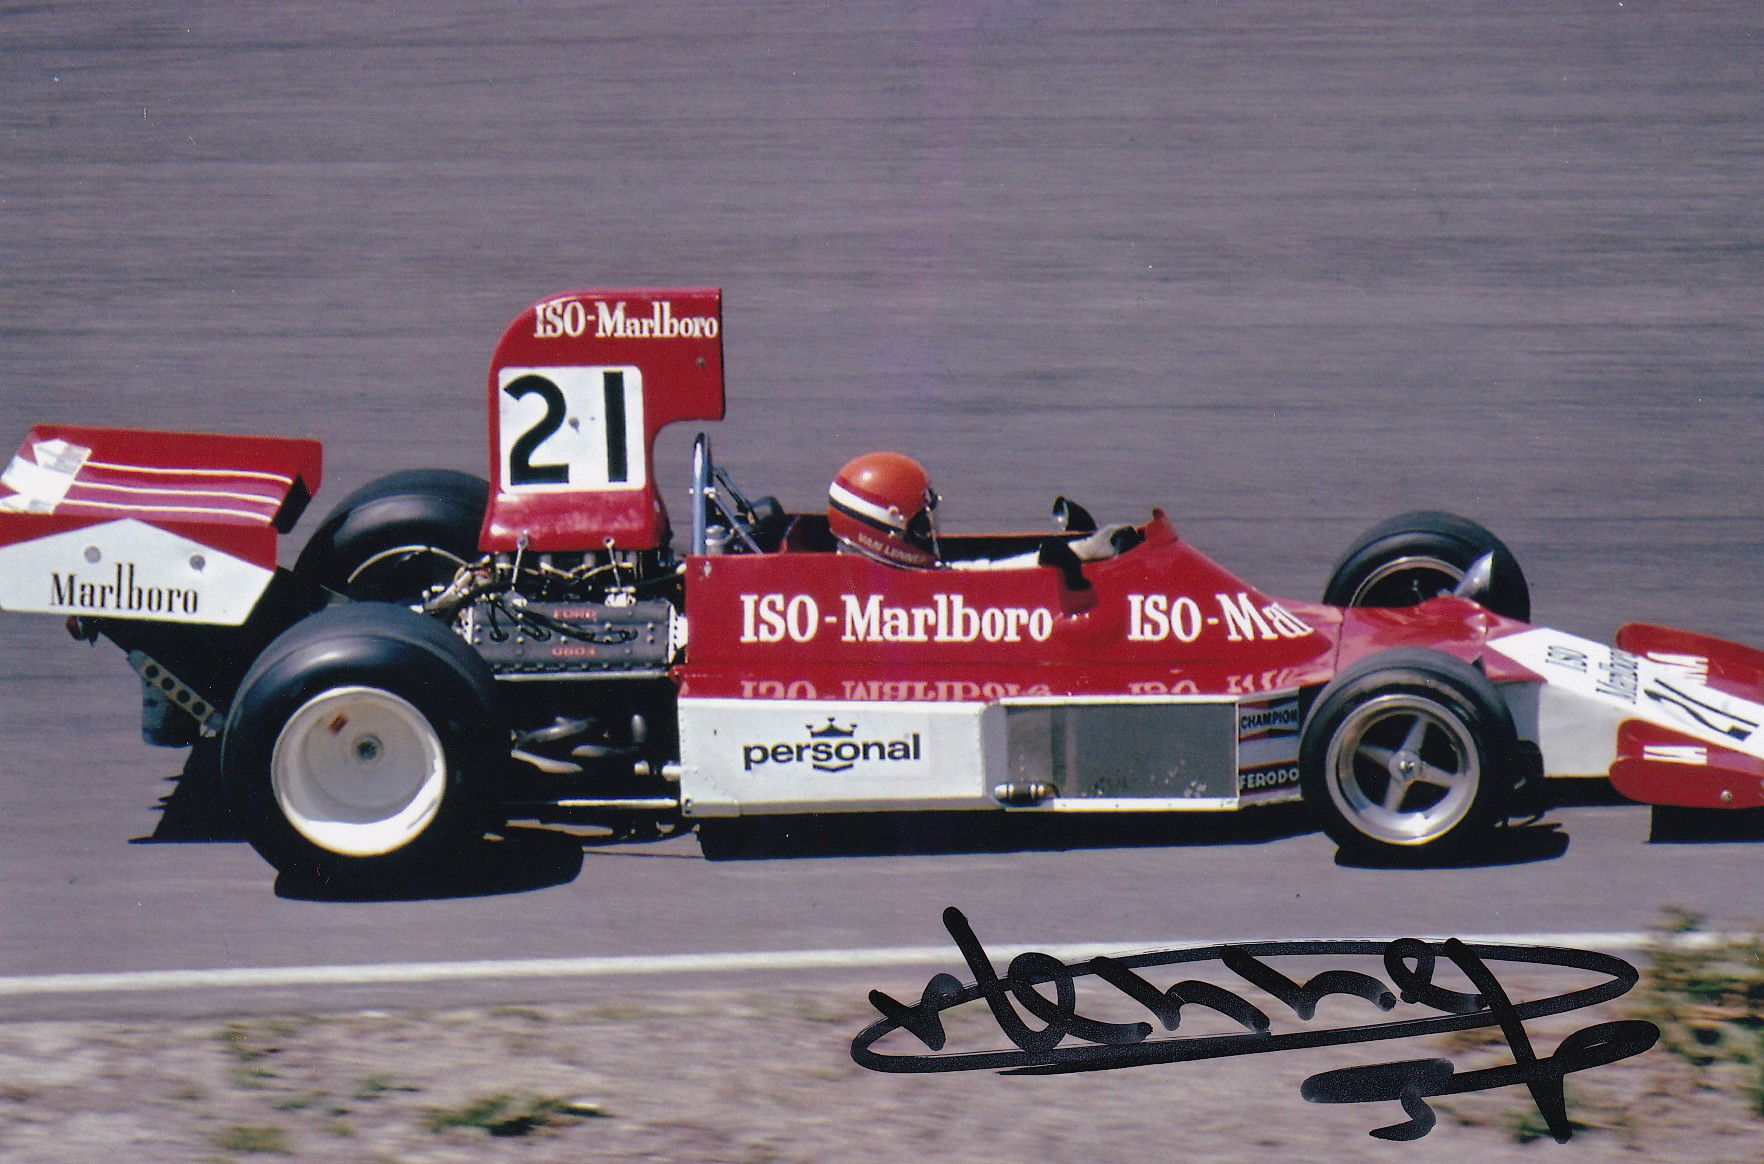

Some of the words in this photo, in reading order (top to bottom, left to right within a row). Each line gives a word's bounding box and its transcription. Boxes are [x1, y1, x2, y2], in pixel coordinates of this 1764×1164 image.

[533, 301, 719, 338] ISO-Marlboro
[503, 370, 628, 486] 21
[51, 562, 199, 613] Marlboro
[740, 593, 1053, 642] ISO-Marlboro
[1241, 708, 1298, 729] CHAMPION
[1643, 677, 1760, 742] 21
[743, 732, 922, 771] personal
[1239, 767, 1300, 791] FERODO
